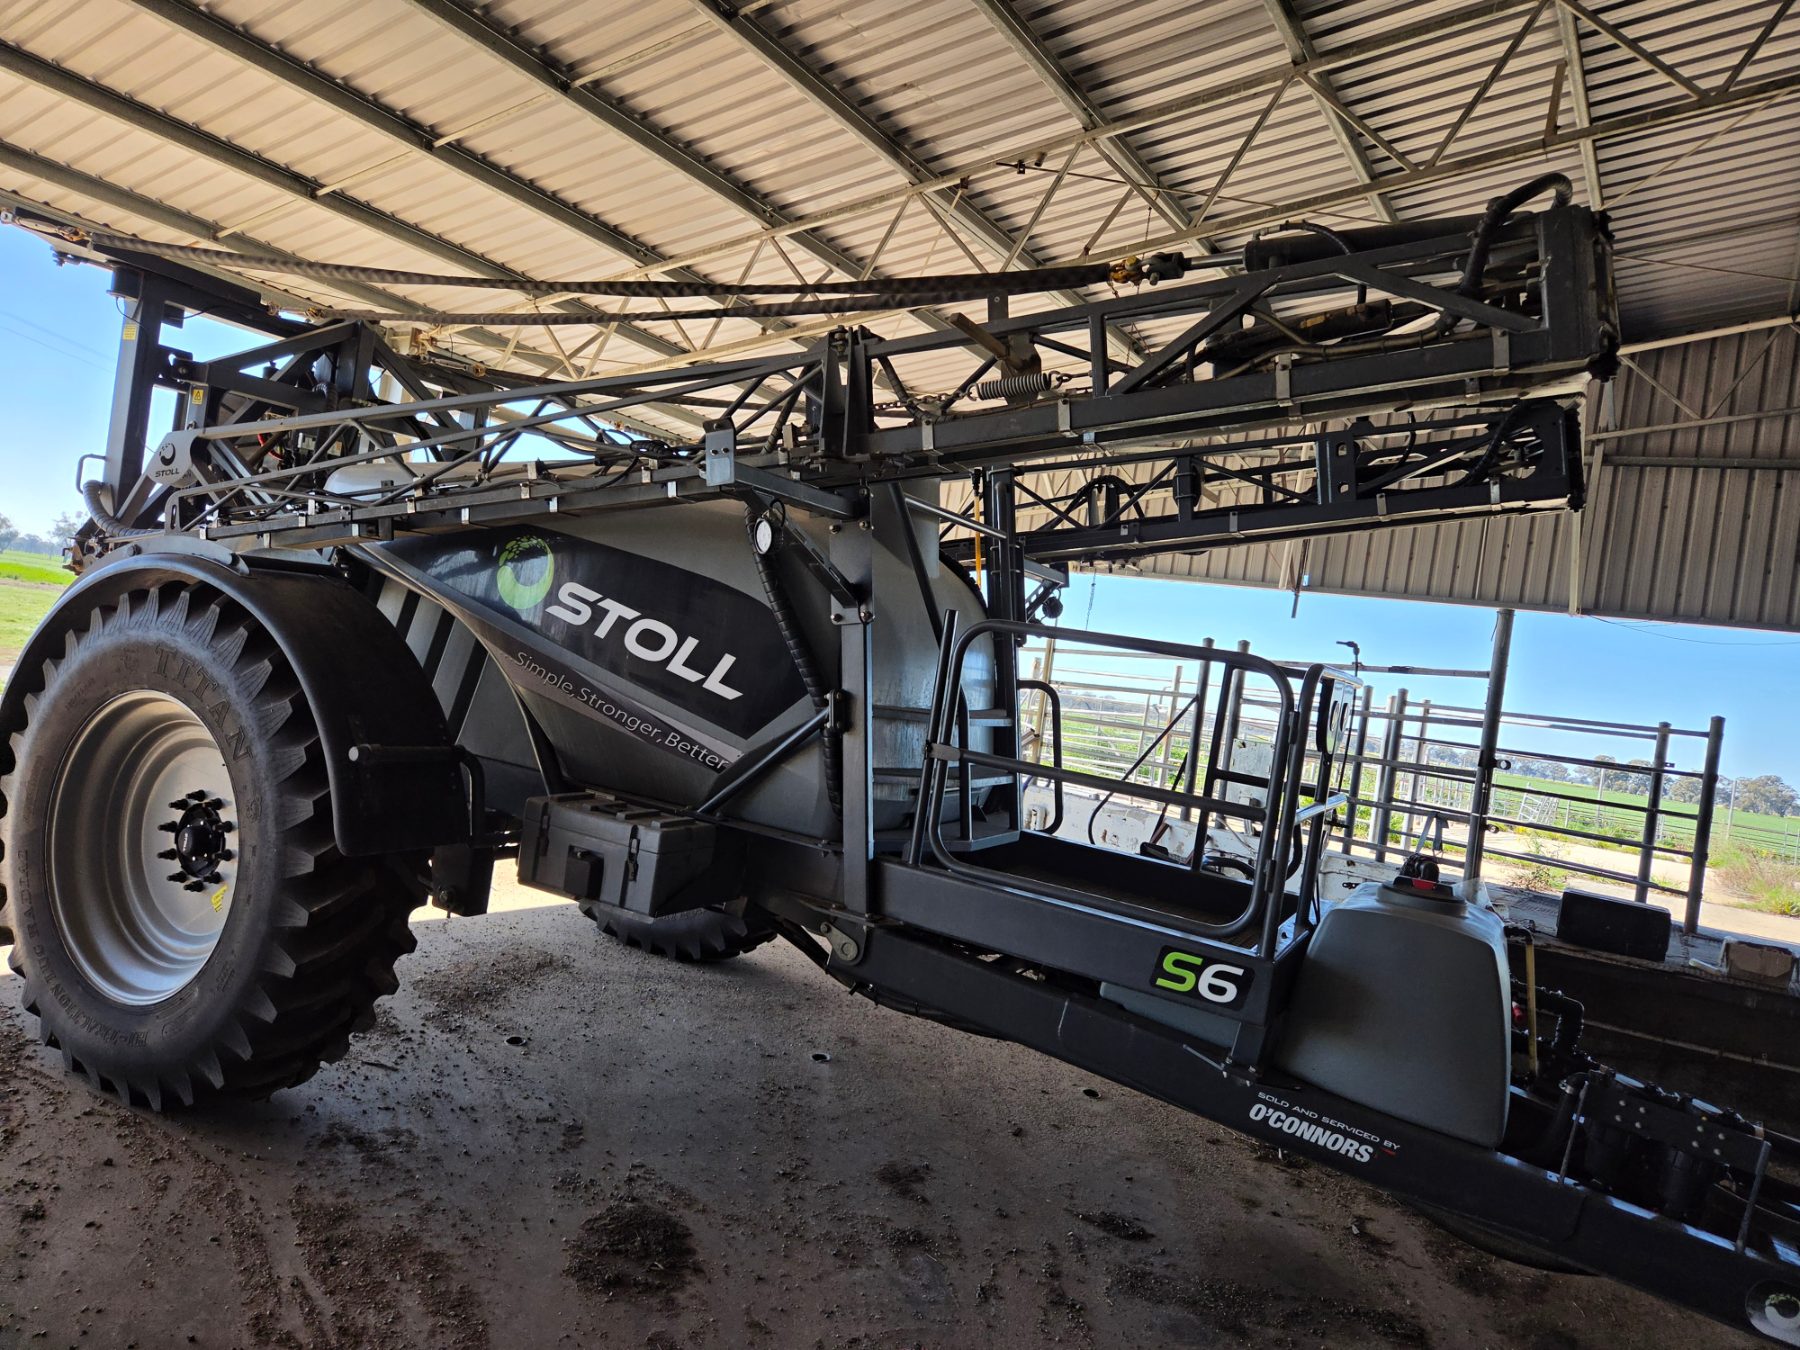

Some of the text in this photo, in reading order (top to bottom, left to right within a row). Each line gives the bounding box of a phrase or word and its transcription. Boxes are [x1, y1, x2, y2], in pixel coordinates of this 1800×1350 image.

[155, 468, 179, 478] STOLL
[545, 582, 744, 700] STOLL
[153, 644, 253, 762] TITAN
[664, 732, 729, 769] Better
[1156, 951, 1244, 1003] S6
[1249, 1103, 1374, 1163] O'CONNORS
[1258, 1091, 1400, 1150] SOLD AND SERVICED BY
